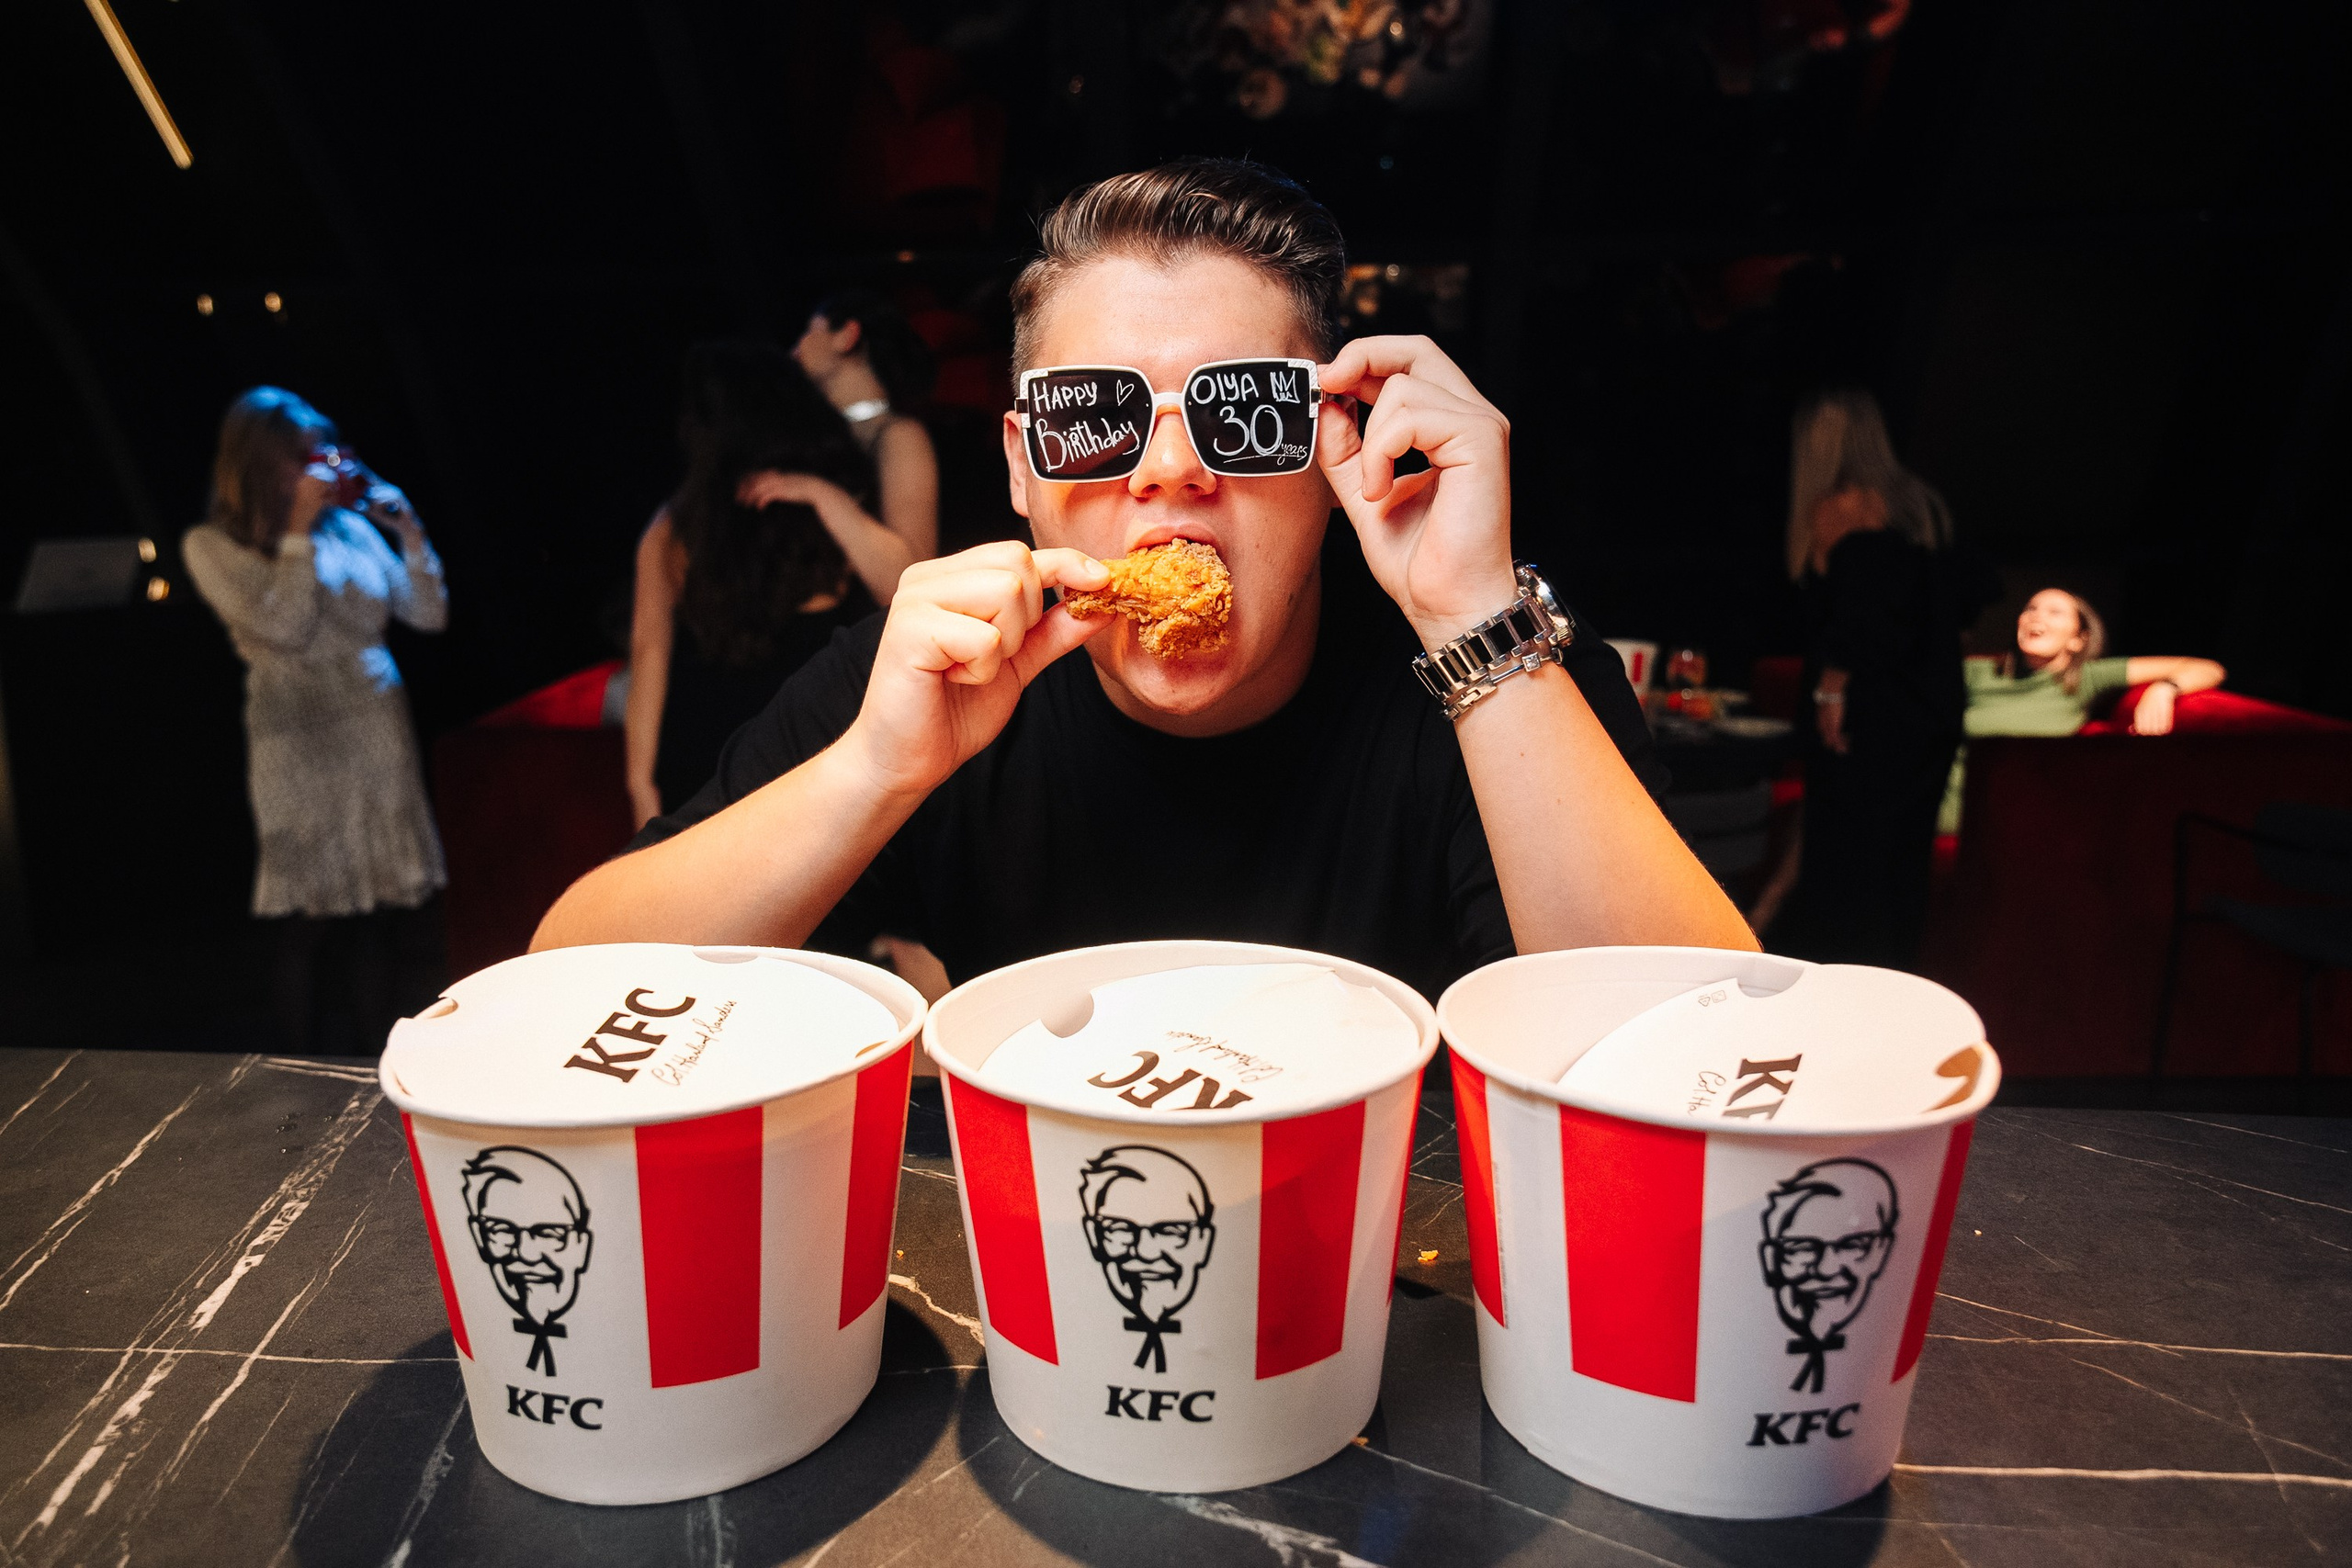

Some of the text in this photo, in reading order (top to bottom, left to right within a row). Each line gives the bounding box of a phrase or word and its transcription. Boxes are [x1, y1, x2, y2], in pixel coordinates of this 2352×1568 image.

[1032, 380, 1098, 413] HAPPY
[1213, 404, 1309, 466] 30 years
[563, 988, 696, 1084] KFC
[505, 1383, 604, 1431] KFC
[1104, 1384, 1216, 1423] KFC
[1747, 1403, 1860, 1447] KFC
